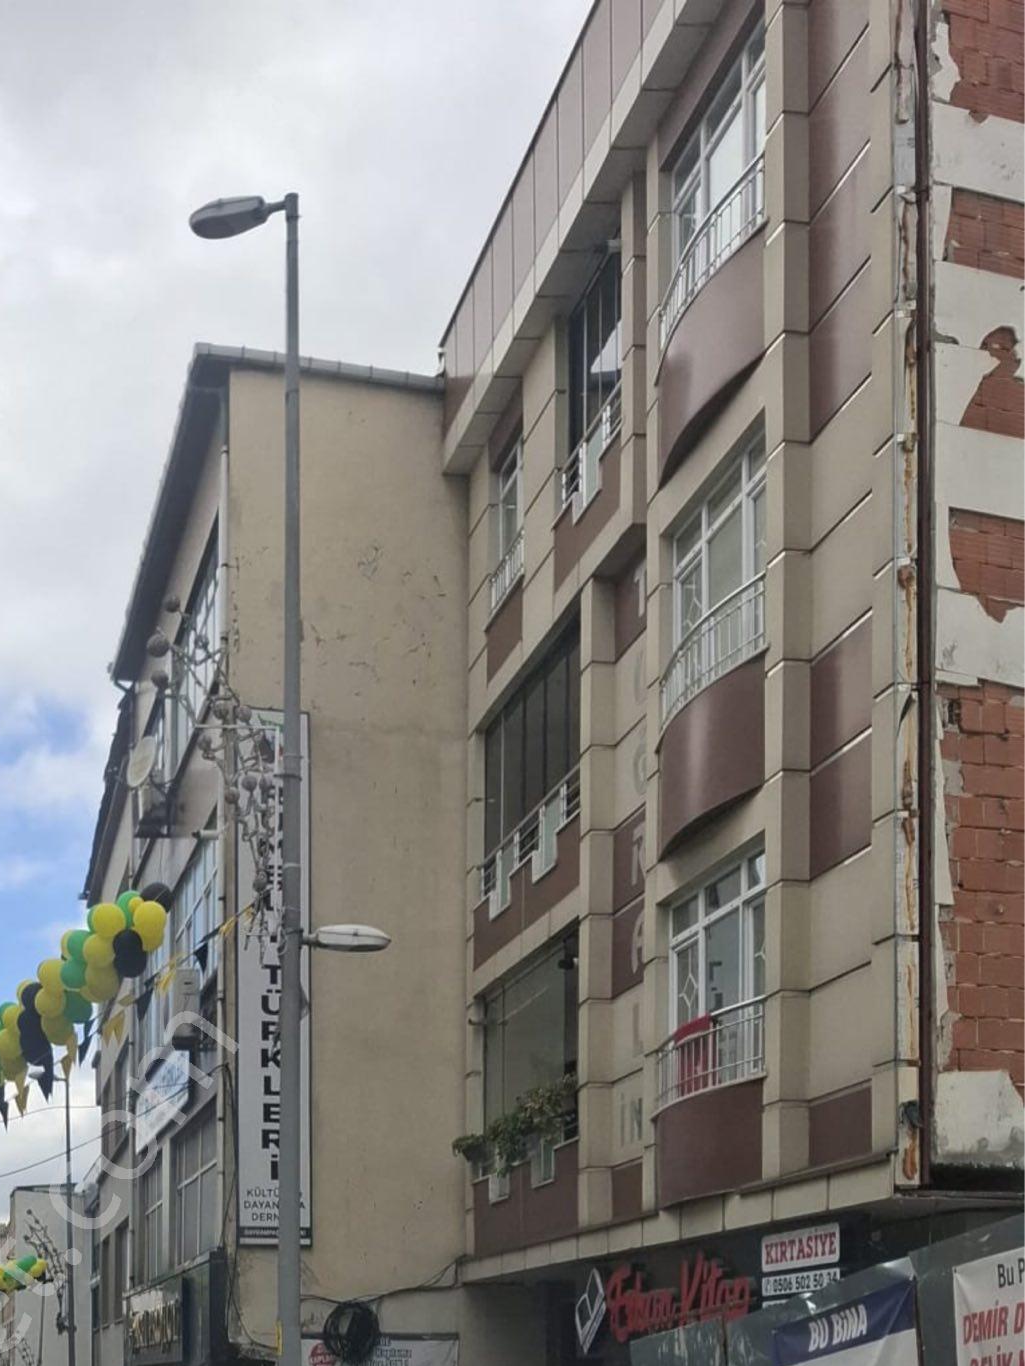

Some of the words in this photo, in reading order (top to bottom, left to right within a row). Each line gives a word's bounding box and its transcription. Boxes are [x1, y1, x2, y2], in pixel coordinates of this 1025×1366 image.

[764, 1230, 837, 1265] KIRTASİYE
[795, 1274, 811, 1290] 502
[813, 1273, 824, 1288] 50
[997, 1263, 1015, 1289] Bu
[808, 1318, 829, 1352] BU
[962, 1299, 1010, 1346] DEMİR
